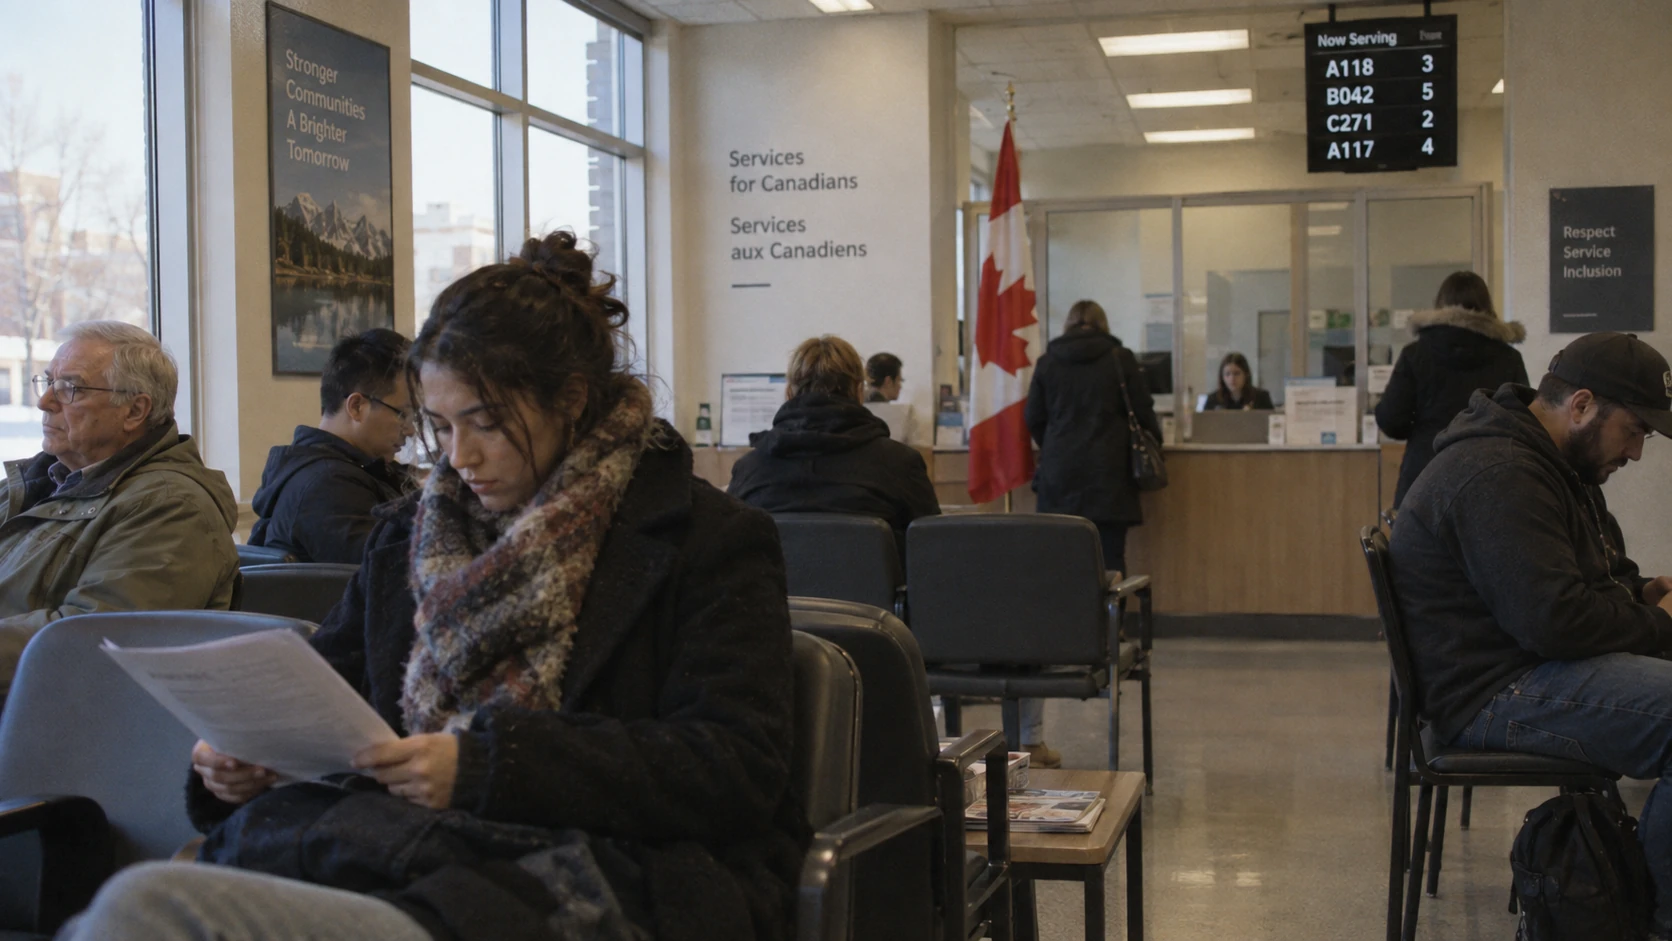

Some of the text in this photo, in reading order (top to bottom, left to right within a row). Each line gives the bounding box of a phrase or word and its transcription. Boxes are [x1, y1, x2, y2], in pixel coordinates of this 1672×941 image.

[1317, 31, 1397, 47] Now Serving
[286, 48, 338, 85] Stronger
[1325, 54, 1434, 78] A118 3
[286, 78, 366, 120] Communities
[1326, 82, 1434, 105] B042 5
[286, 109, 347, 143] A Brighter
[1326, 109, 1434, 132] C271 2
[286, 138, 350, 172] Tomorrow
[729, 149, 804, 167] Services
[1326, 136, 1434, 160] A117 4
[729, 172, 858, 193] for Canadians
[730, 215, 806, 235] Services
[1563, 226, 1616, 240] Respect
[731, 240, 867, 260] aux Canadiens
[1563, 245, 1611, 259] Service
[1563, 264, 1622, 278] Inclusion
